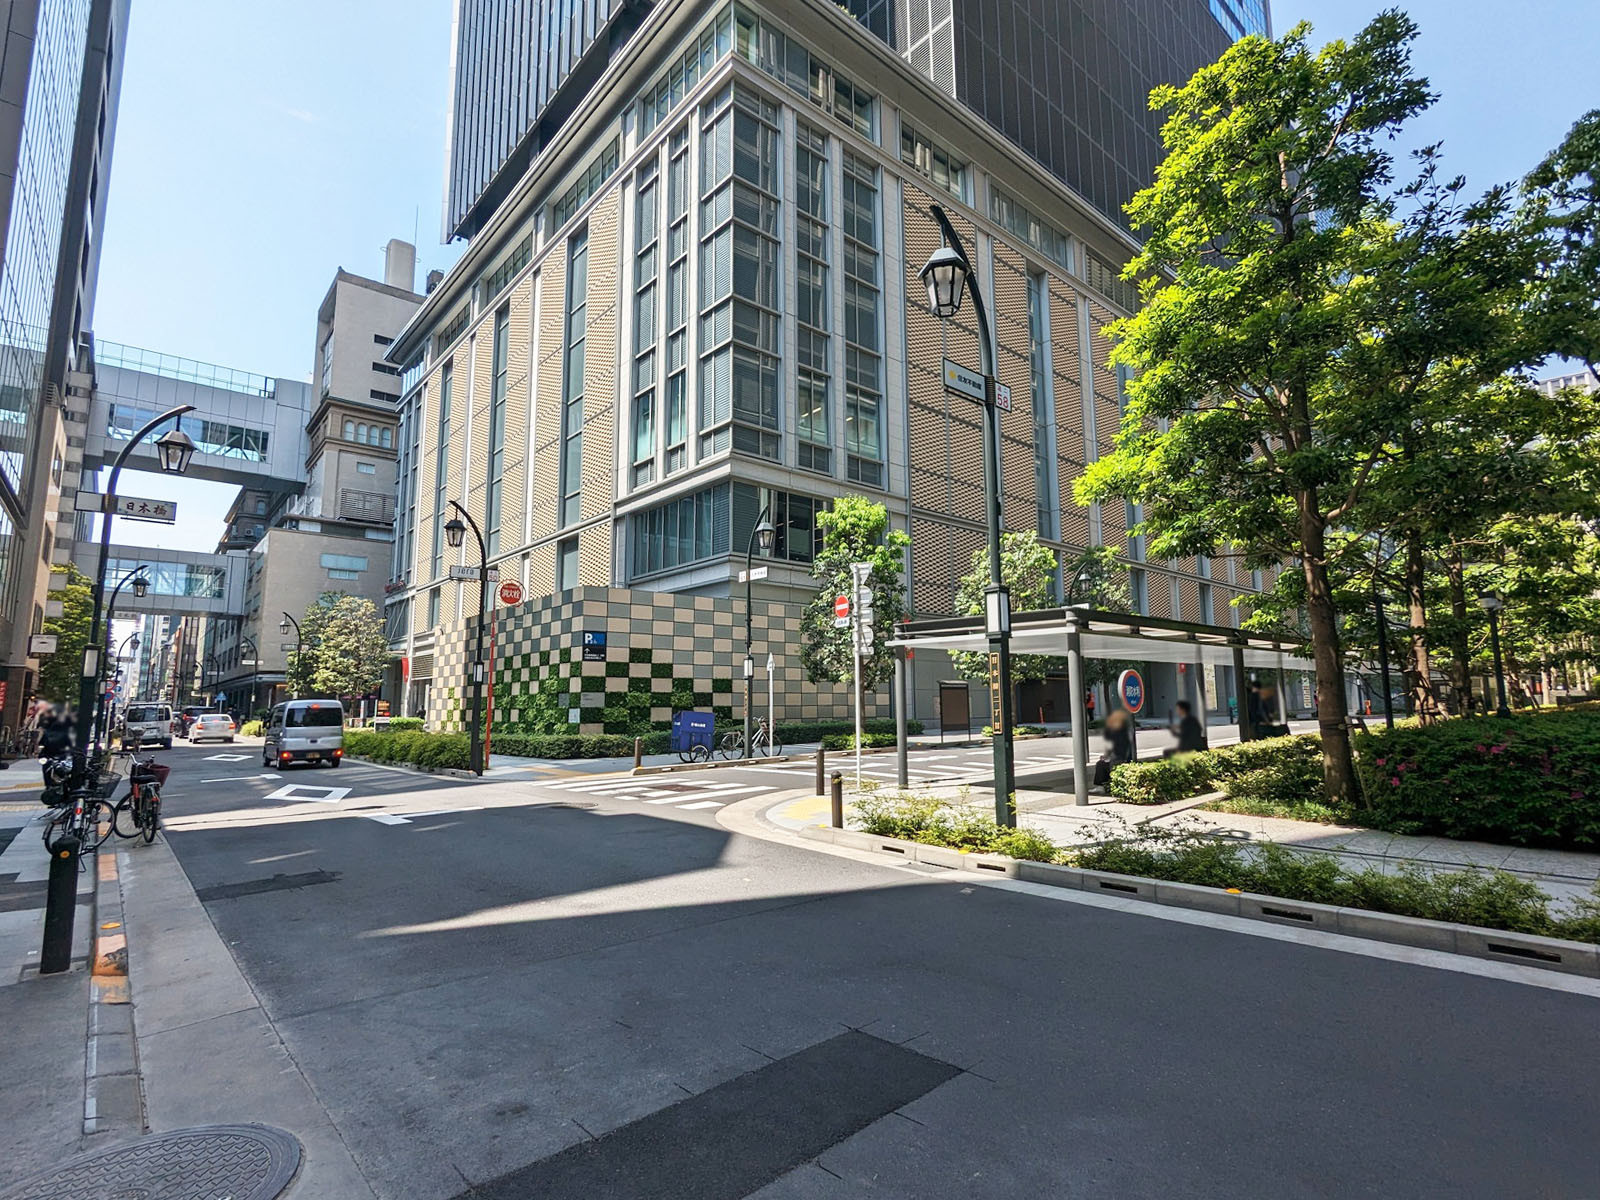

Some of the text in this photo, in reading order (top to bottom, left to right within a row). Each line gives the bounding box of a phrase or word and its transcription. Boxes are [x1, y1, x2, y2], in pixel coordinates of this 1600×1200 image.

[997, 394, 1009, 409] 58
[126, 502, 168, 516] 日本橋
[585, 633, 593, 644] P
